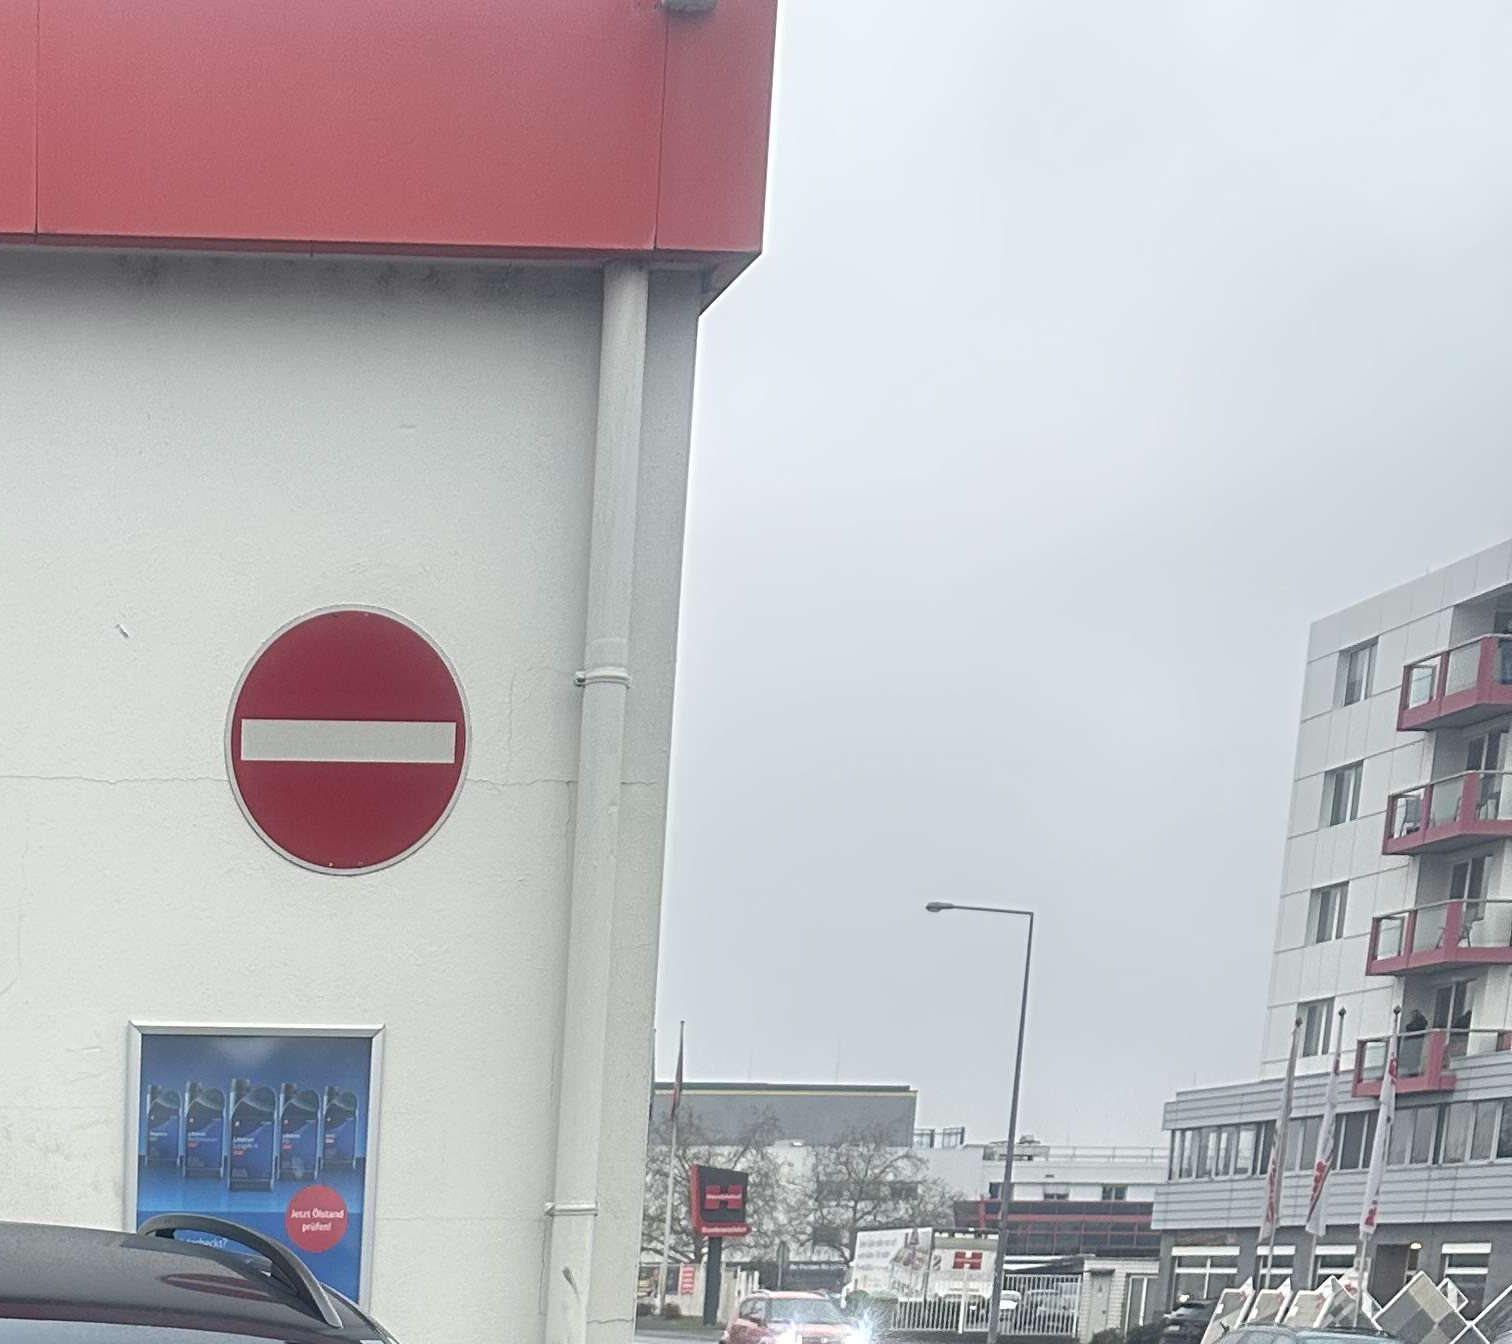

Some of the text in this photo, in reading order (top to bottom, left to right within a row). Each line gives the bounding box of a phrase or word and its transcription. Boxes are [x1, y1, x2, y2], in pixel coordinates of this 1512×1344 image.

[291, 1207, 345, 1219] Jetzt Ölstand
[302, 1222, 332, 1233] prüfen!
